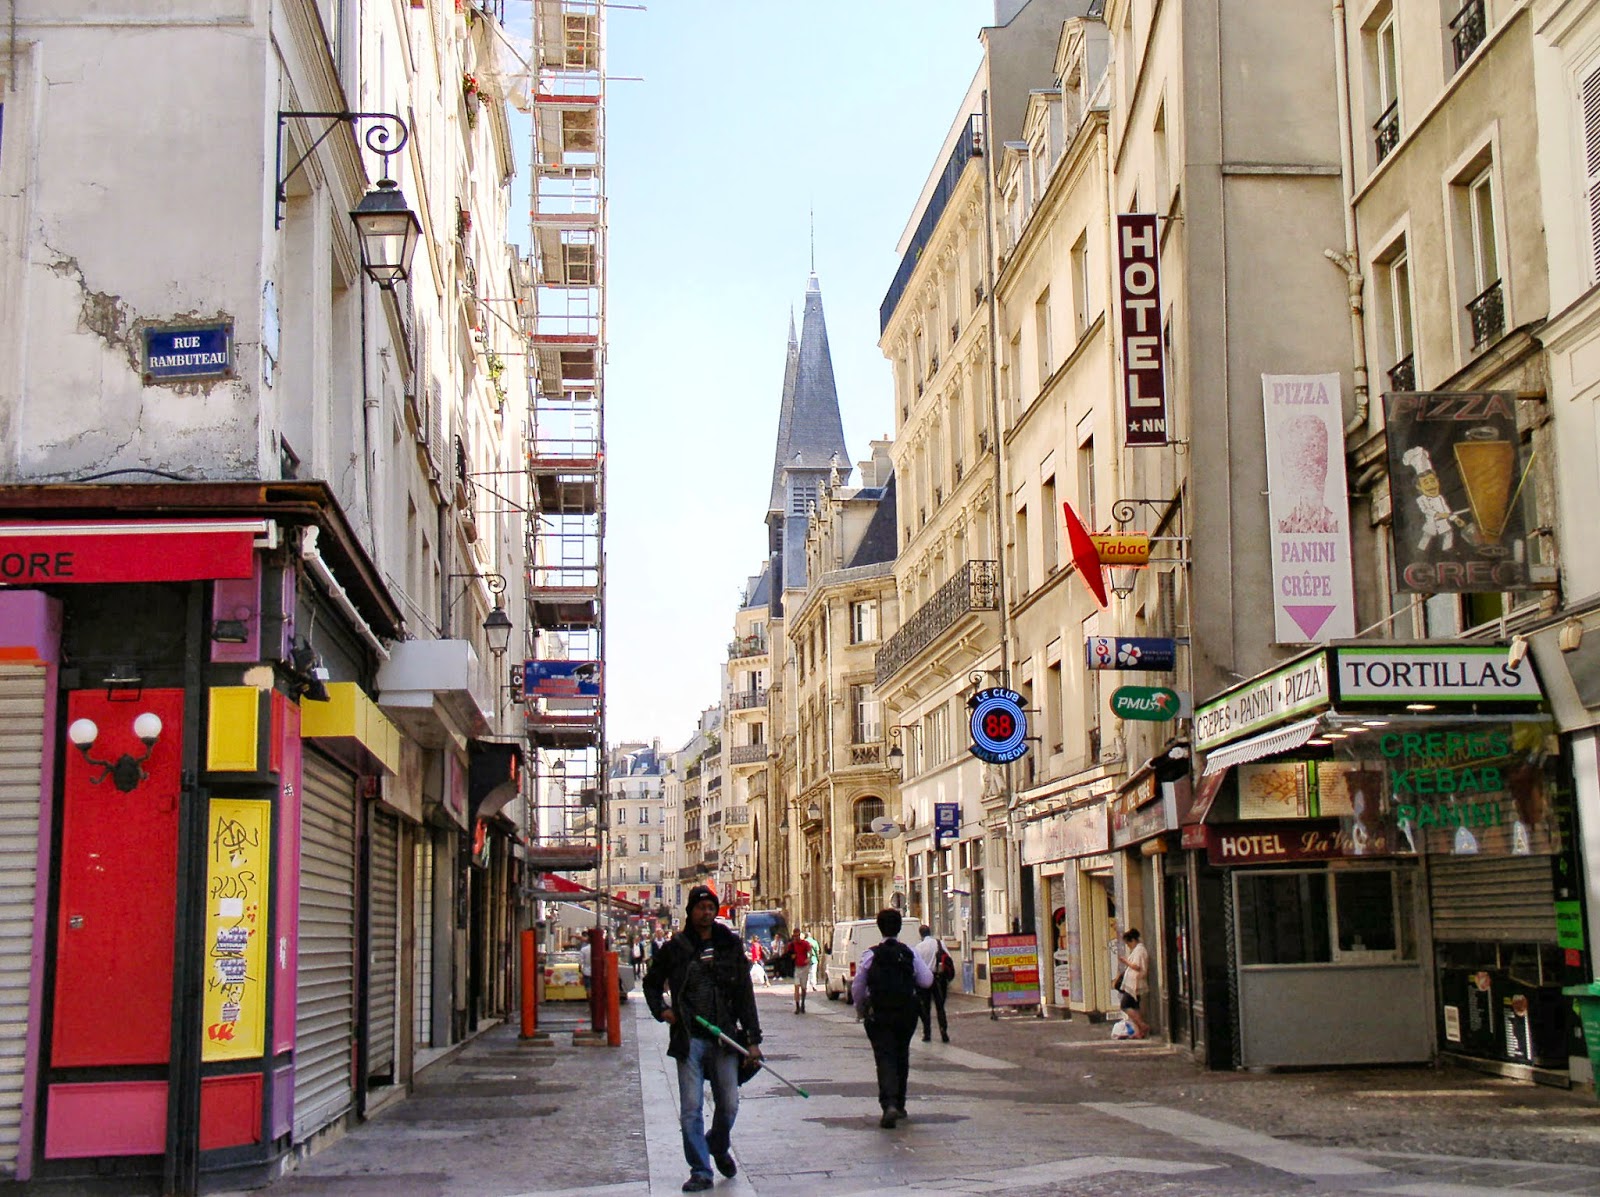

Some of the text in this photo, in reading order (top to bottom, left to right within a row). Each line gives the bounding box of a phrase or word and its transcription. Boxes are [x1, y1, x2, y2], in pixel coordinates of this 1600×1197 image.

[1121, 225, 1160, 407] HOTEL
[173, 336, 201, 349] RUE
[149, 352, 226, 368] RAMBUTEAU
[1272, 381, 1330, 405] PIZZA
[1388, 394, 1514, 422] PIZZA
[1142, 418, 1165, 433] NN
[1097, 541, 1146, 556] Tabac
[1280, 541, 1336, 563] PANINI
[1, 552, 75, 578] ORE
[1403, 560, 1524, 588] GREC
[1281, 569, 1332, 597] CRÊPE
[1345, 661, 1522, 688] TORTILLAS
[975, 688, 1020, 702] LE CLUB
[1117, 696, 1152, 710] PMU
[1196, 666, 1322, 741] CREPES PANINI PIZZA
[986, 714, 1012, 737] 88
[1379, 732, 1509, 759] CREPES
[1391, 765, 1504, 795] KEBAB
[1397, 803, 1502, 832] PANINI
[1221, 835, 1286, 857] HOTEL
[990, 946, 1036, 956] MASSAGES
[991, 957, 1010, 966] LOVE
